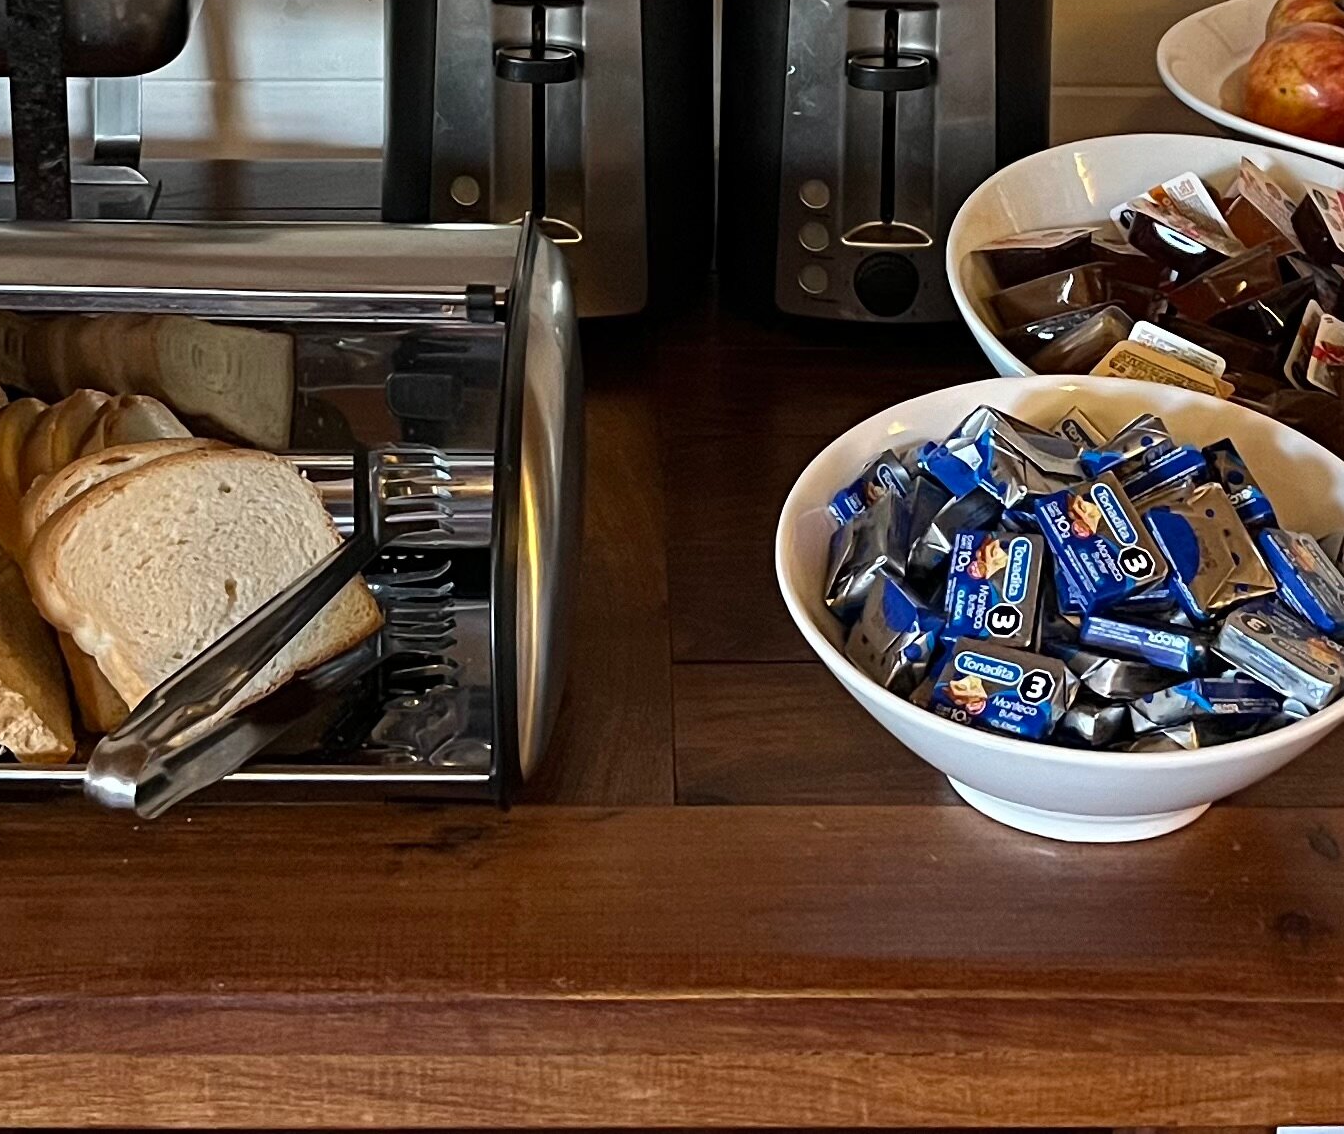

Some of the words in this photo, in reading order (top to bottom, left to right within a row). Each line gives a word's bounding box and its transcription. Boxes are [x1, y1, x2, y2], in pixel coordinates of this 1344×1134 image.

[1097, 488, 1131, 541] Tonadita
[1008, 544, 1027, 596] Tonadita
[1123, 553, 1148, 573] 3
[991, 612, 1016, 629] 3
[962, 656, 1015, 681] Tonadita
[1025, 675, 1047, 699] 3
[992, 696, 1038, 716] Manteca
